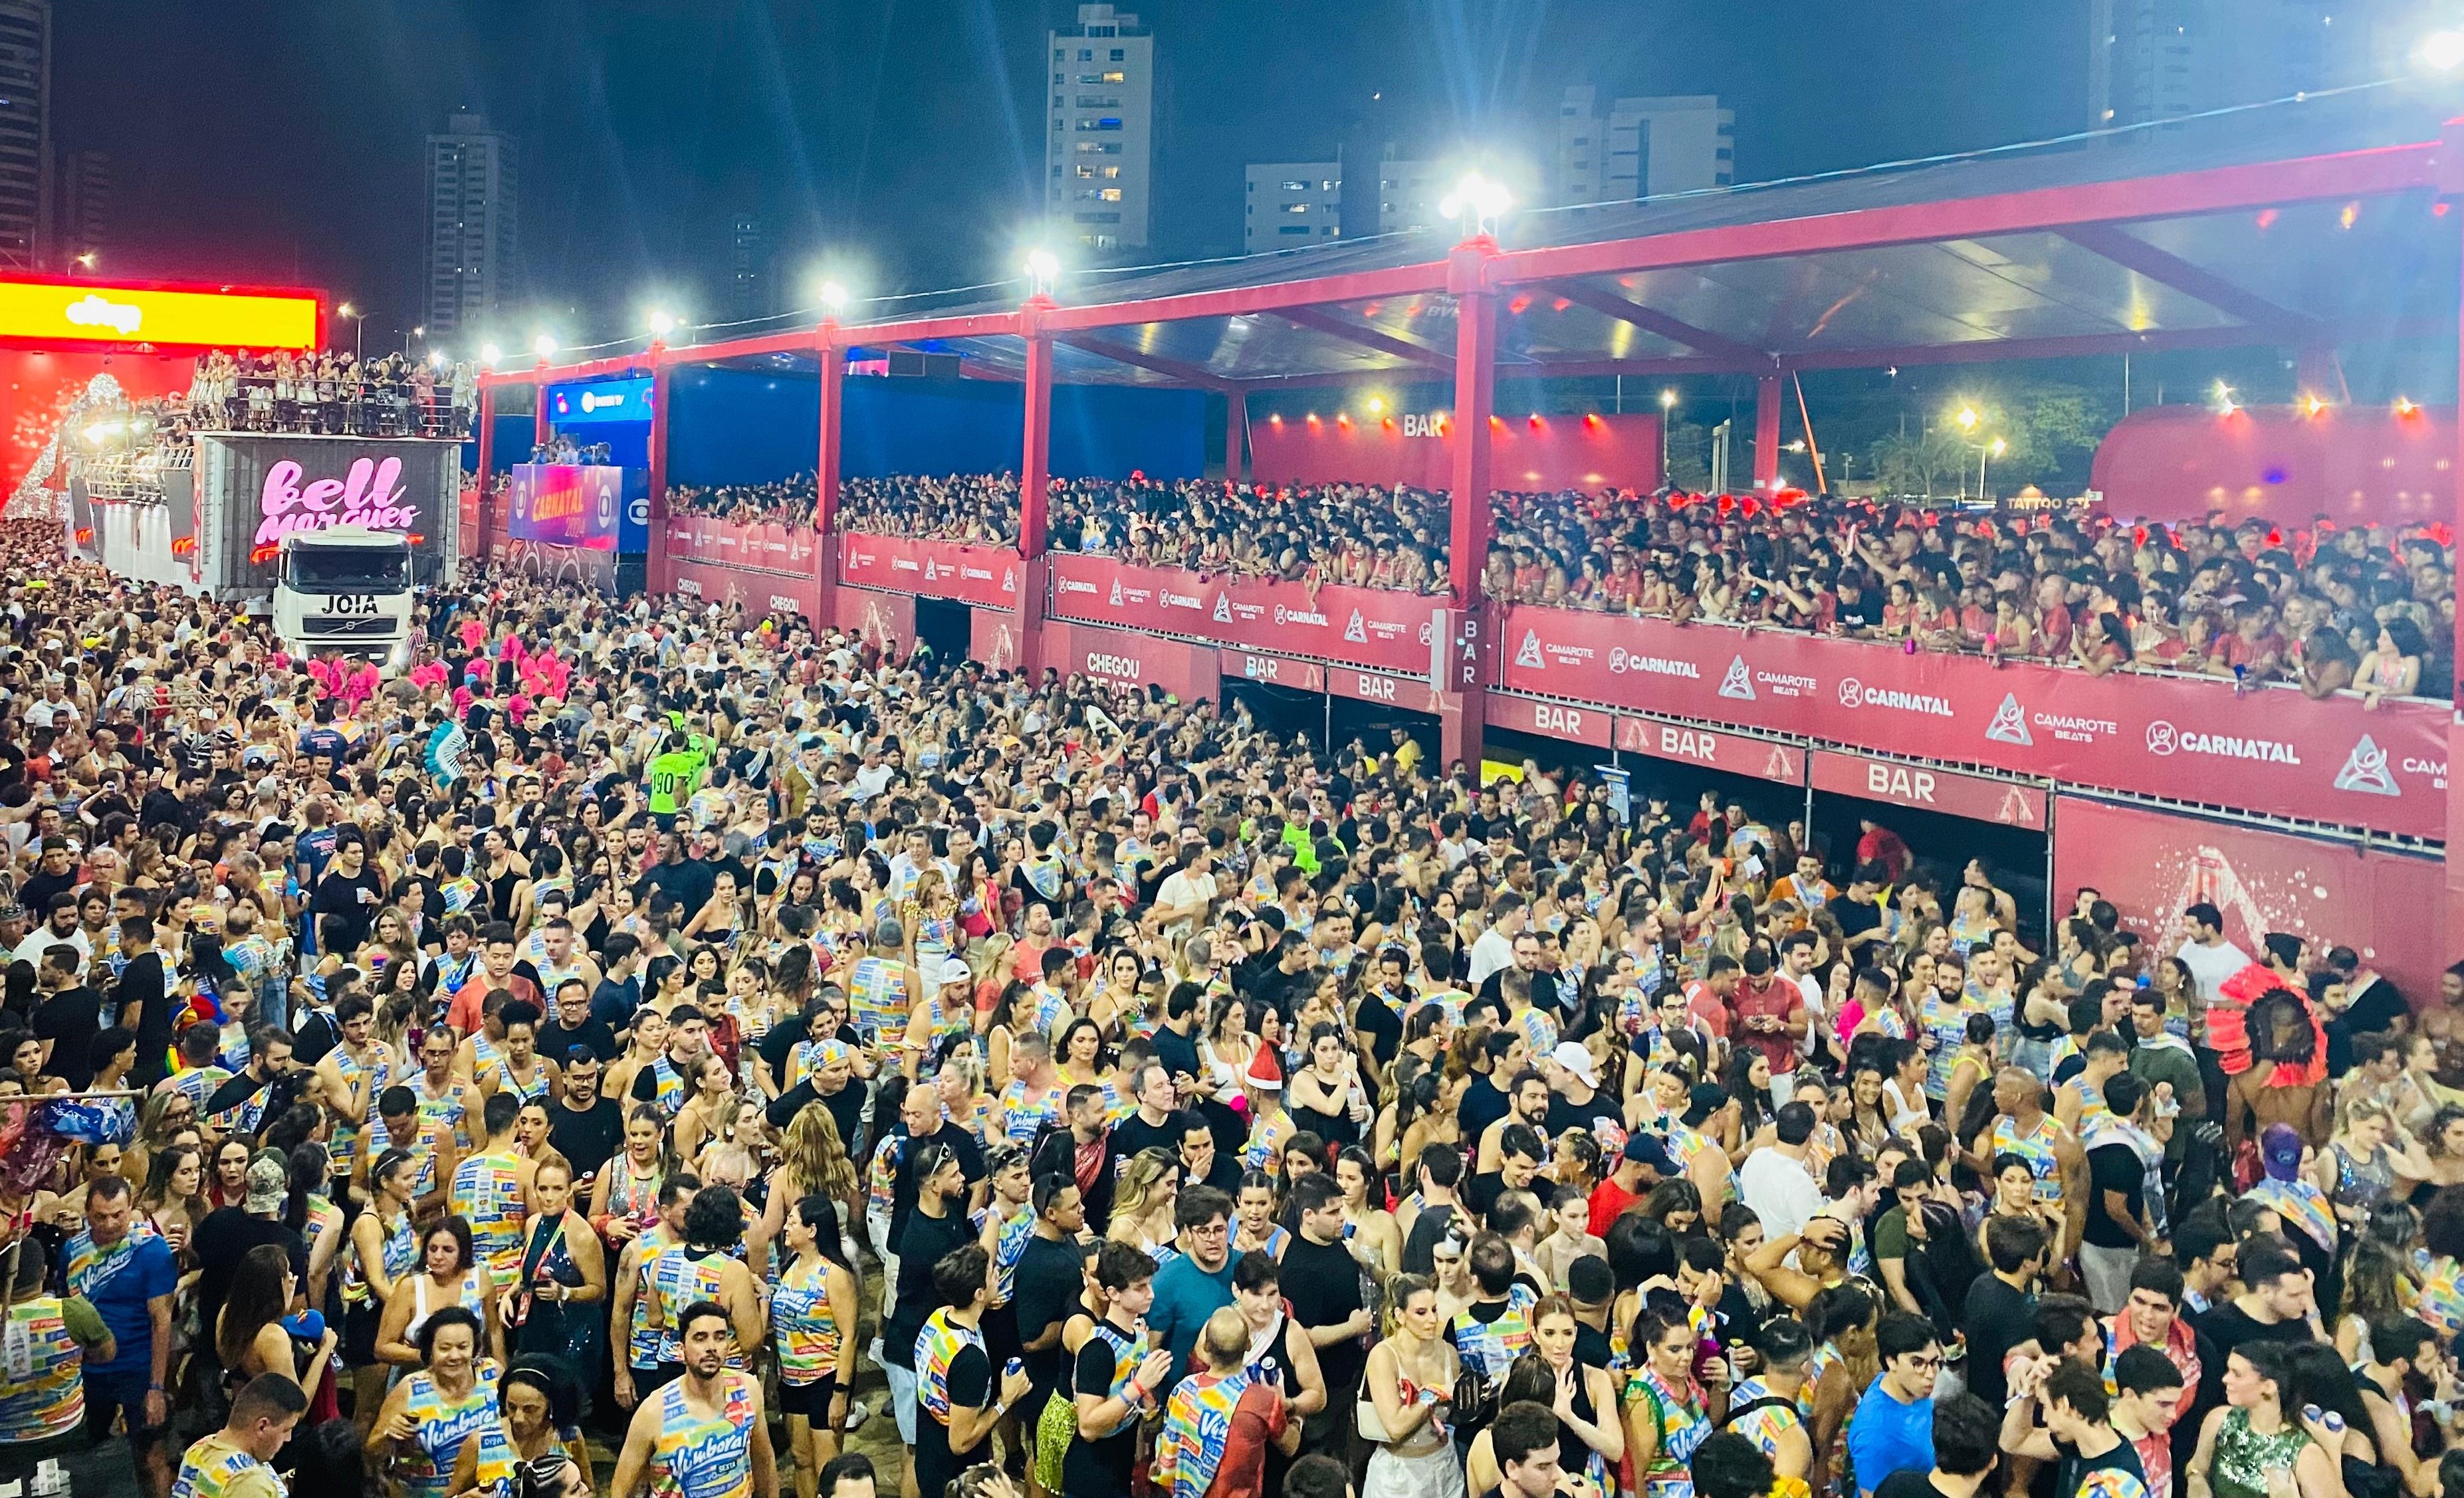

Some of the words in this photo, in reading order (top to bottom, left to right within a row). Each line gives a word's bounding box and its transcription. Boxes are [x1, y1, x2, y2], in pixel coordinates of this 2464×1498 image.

[1404, 407, 1444, 437] BAR
[532, 487, 584, 522] CARNATAL
[2007, 497, 2062, 510] TATTOO
[565, 518, 586, 538] 2024
[677, 578, 702, 595] CHEGOU
[1066, 580, 1098, 594] CARNATAL
[322, 594, 378, 614] JOIA
[770, 594, 800, 613] CHEGOU
[1169, 594, 1203, 610] CARNATAL
[1232, 602, 1265, 614] CAMAROTE
[1286, 609, 1329, 627] CARNATAL
[1367, 619, 1407, 633] CAMAROTE
[1545, 642, 1595, 659] CAMAROTE
[1087, 652, 1140, 679] CHEGOU
[1246, 656, 1278, 680] BAR
[1629, 654, 1701, 679] CARNATAL
[1359, 674, 1396, 701] BAR
[1757, 671, 1817, 690] CAMAROTE
[1864, 687, 1955, 717] CARNATAL
[1535, 704, 1582, 736] BAR
[2034, 712, 2118, 734] CAMAROTE
[1661, 727, 1716, 762] BAR
[2180, 731, 2301, 765] CARNATAL
[653, 772, 674, 795] 190
[1868, 763, 1936, 803] BAR
